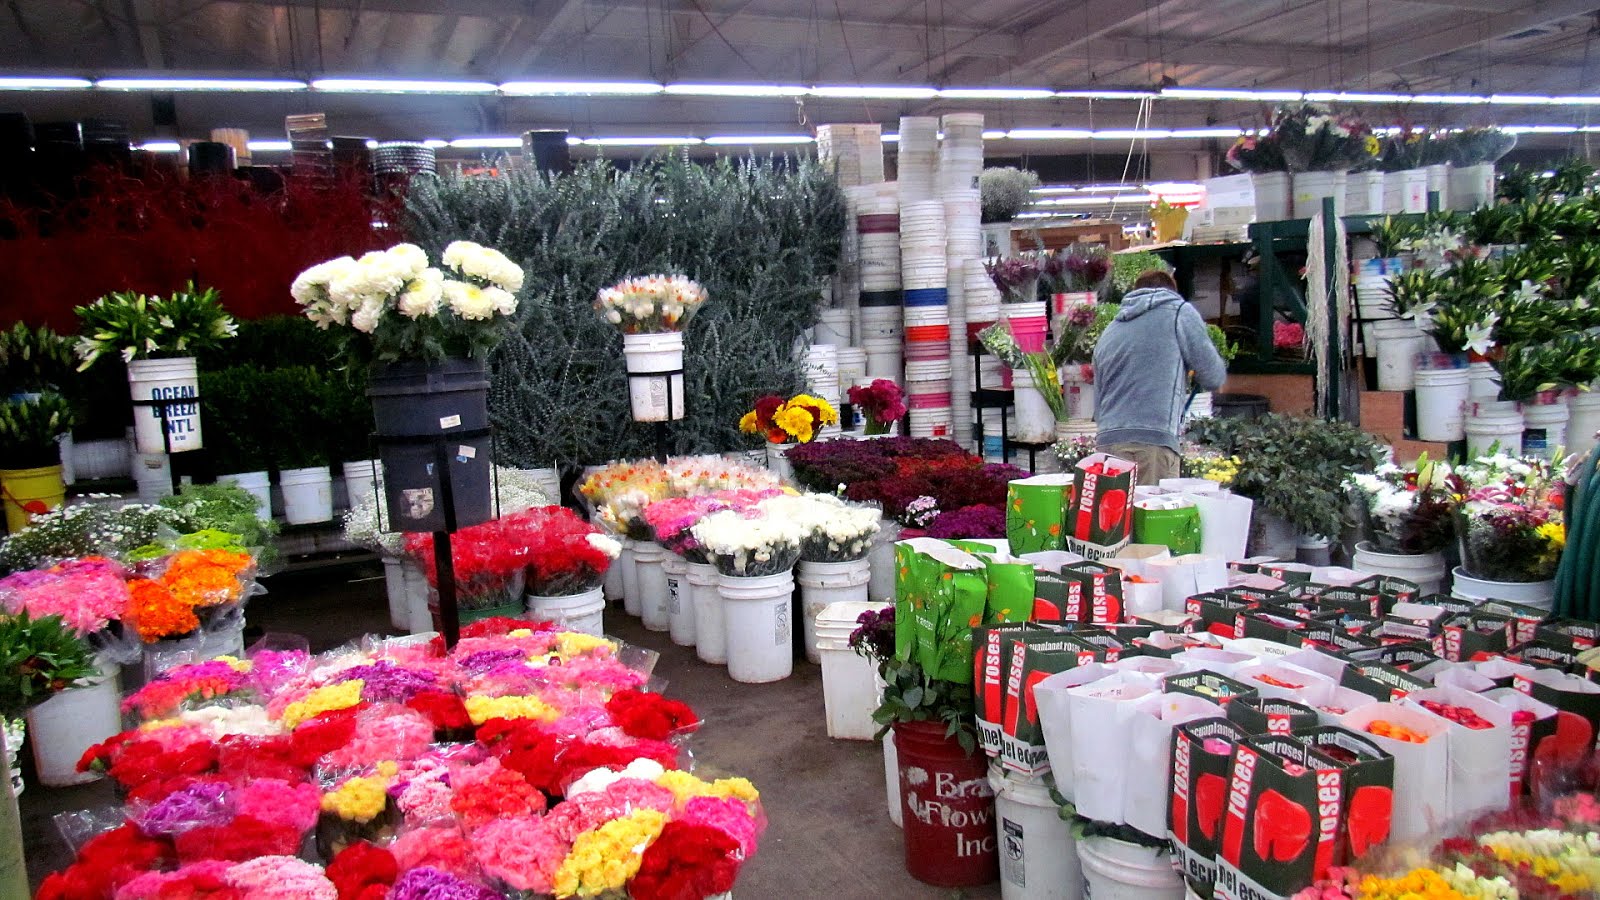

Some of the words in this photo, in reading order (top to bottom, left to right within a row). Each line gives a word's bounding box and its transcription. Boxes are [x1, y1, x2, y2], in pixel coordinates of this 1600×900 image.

[152, 386, 195, 400] OCEAN
[152, 402, 197, 418] BREEZE
[168, 419, 195, 433] NT'L
[1080, 472, 1097, 512] roses
[1065, 584, 1081, 621] oses
[1093, 577, 1108, 623] roses
[1308, 631, 1331, 641] roses
[985, 631, 1000, 685] roses
[1007, 643, 1025, 698] roses
[1174, 736, 1189, 800] roses
[1276, 742, 1303, 762] roses
[935, 772, 990, 798] Bra
[1228, 749, 1255, 820] roses
[1317, 772, 1340, 842] roses
